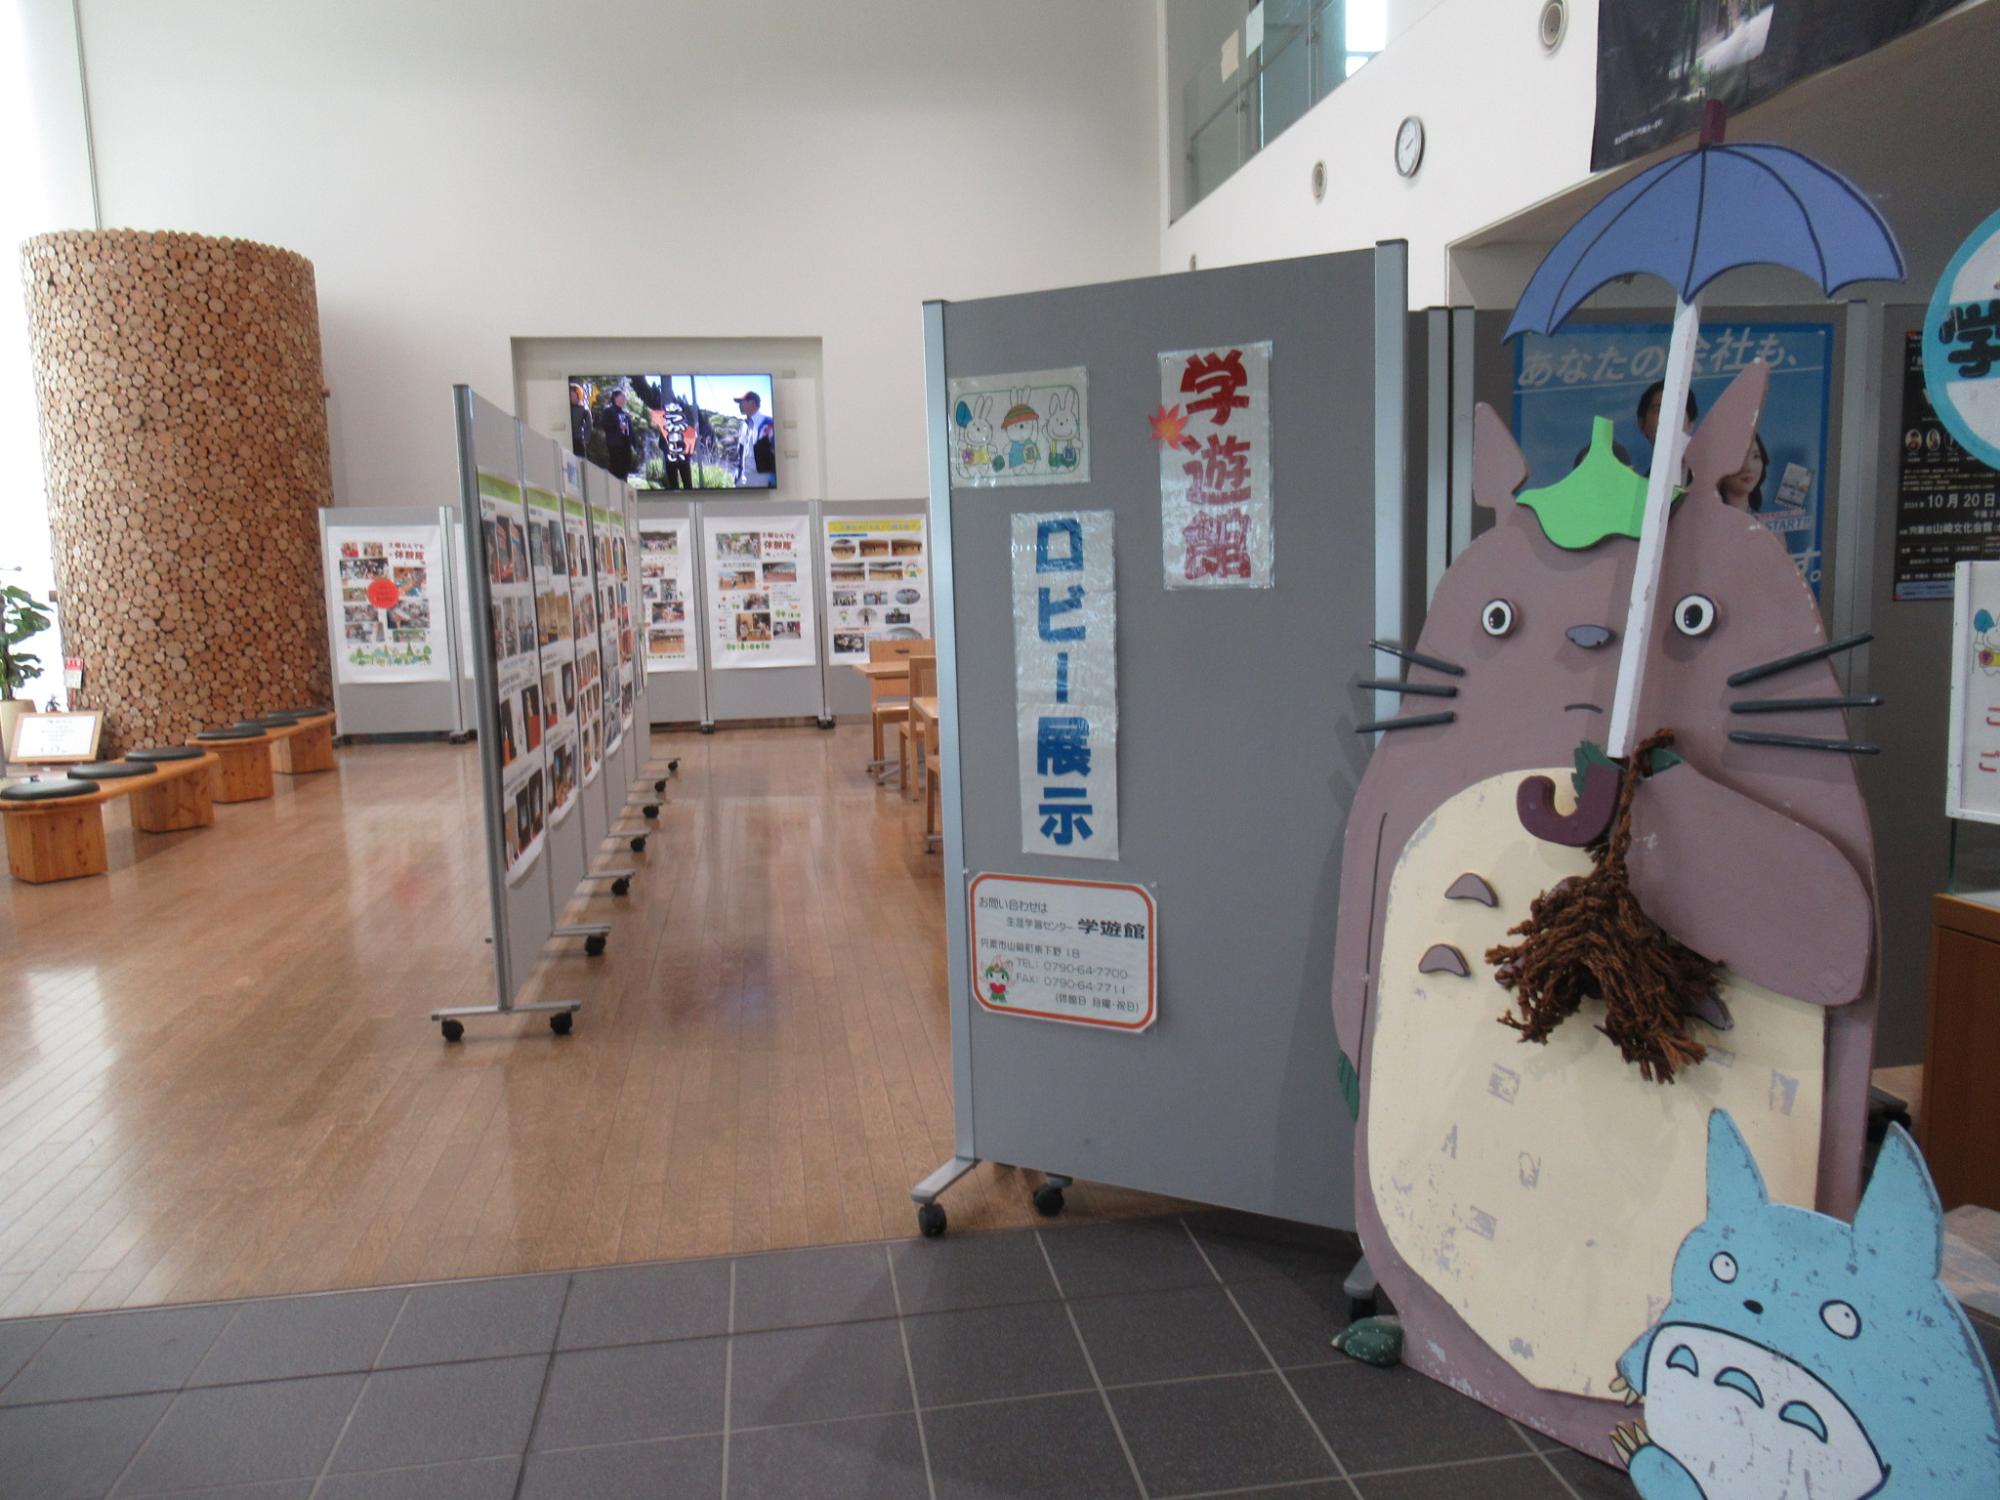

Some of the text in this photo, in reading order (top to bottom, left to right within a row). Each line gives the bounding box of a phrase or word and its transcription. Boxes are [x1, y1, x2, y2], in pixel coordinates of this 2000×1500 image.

[1180, 348, 1252, 581] 学遊館
[1036, 517, 1094, 846] ロビー展示
[979, 897, 1047, 913] お問い合わせは
[1078, 918, 1145, 939] 学遊館
[1043, 960, 1129, 981] 0790-64-7700
[1043, 975, 1126, 996] 0790-64-7711
